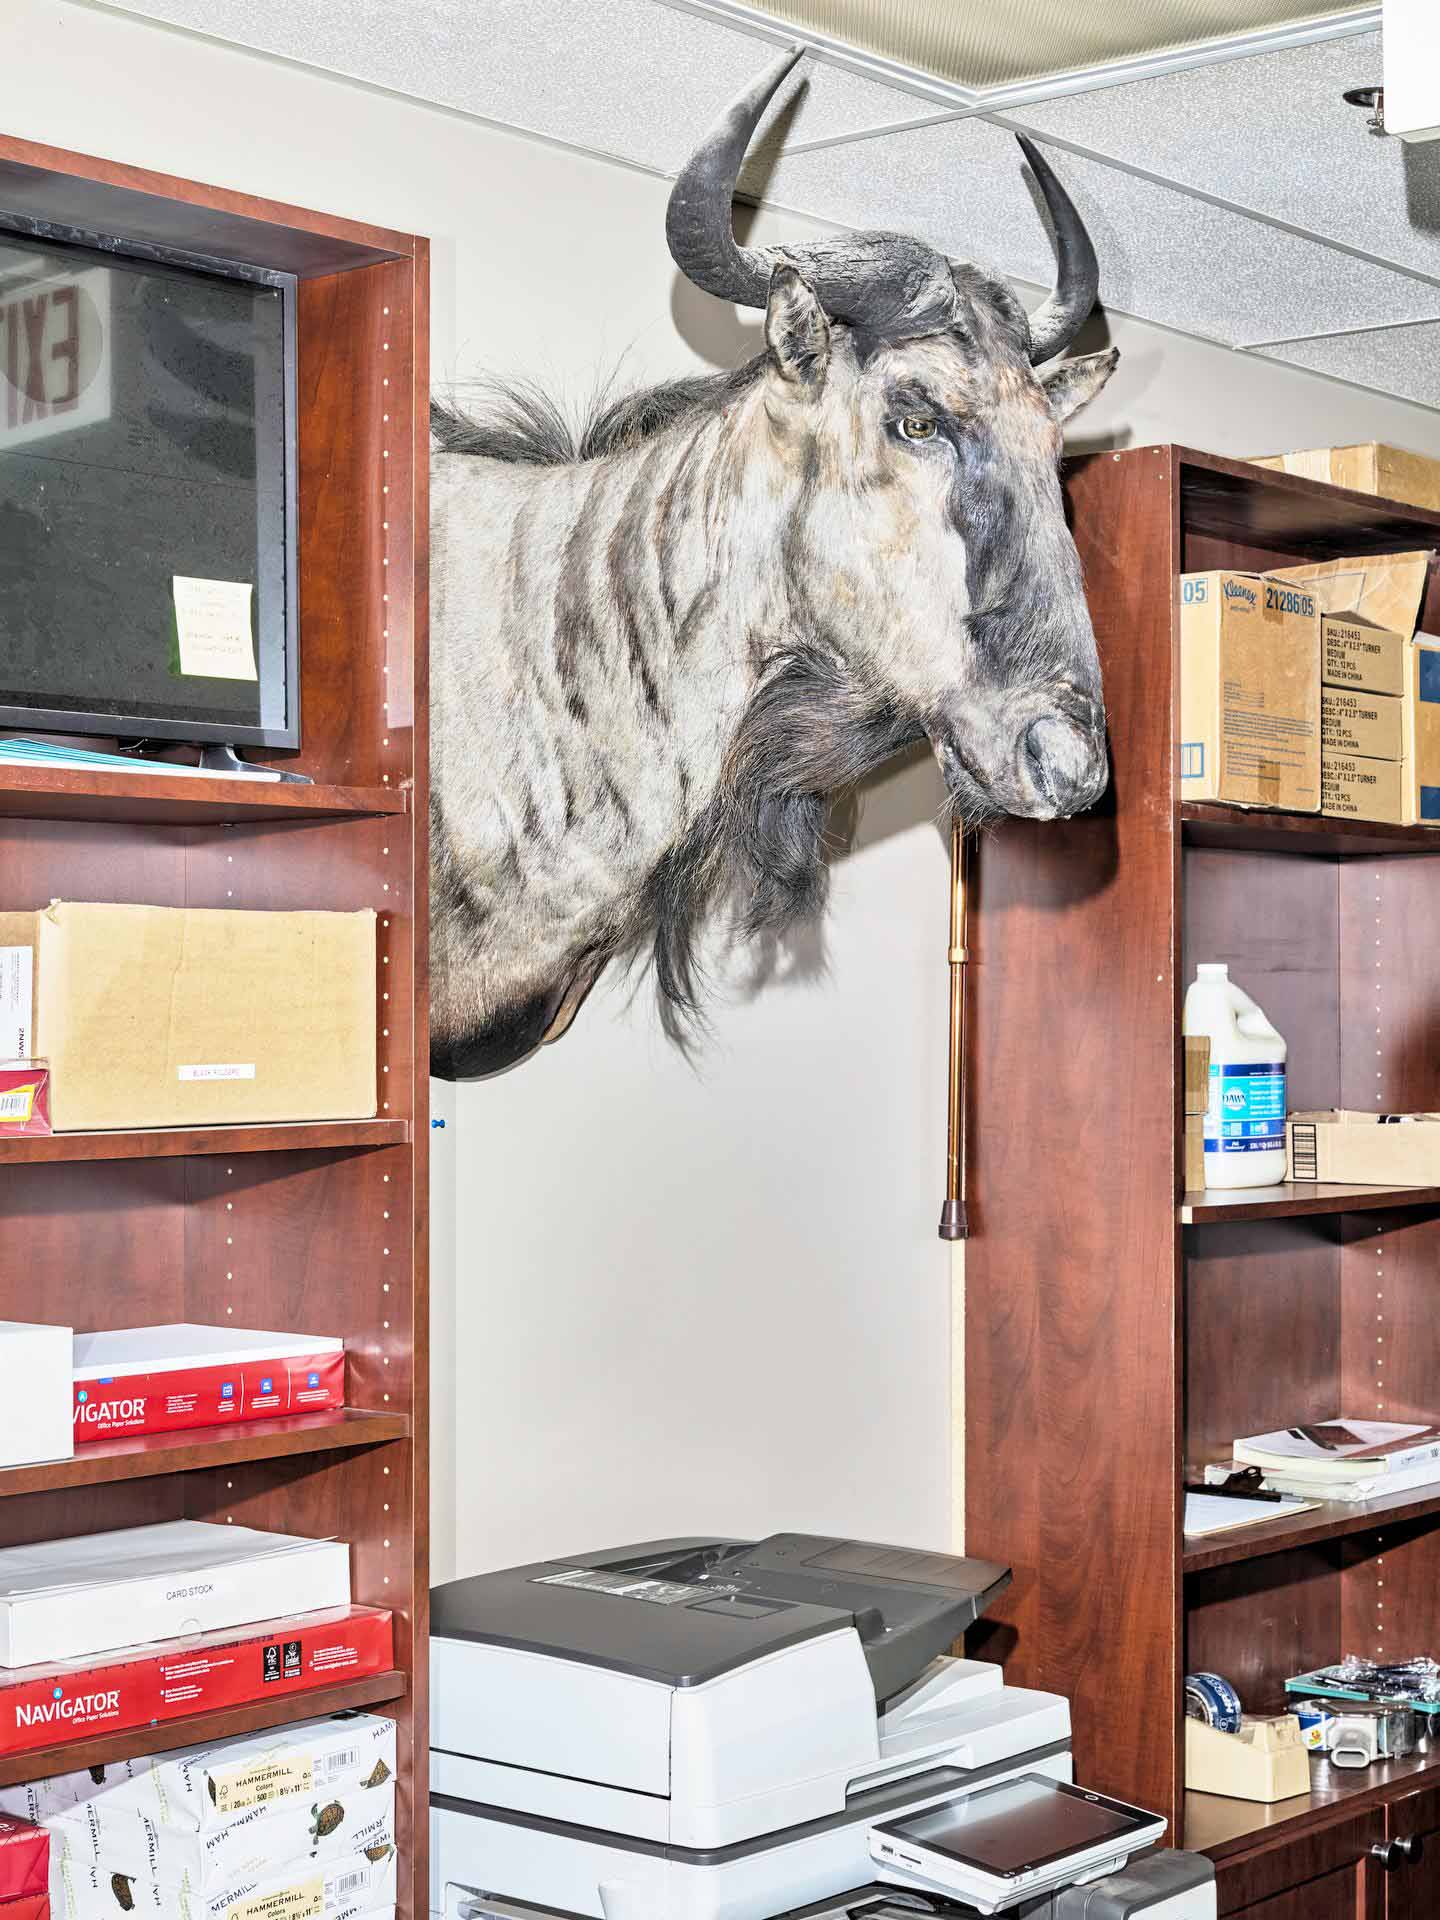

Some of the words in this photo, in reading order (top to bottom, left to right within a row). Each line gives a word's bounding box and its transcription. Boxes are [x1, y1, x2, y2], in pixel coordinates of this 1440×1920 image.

[1184, 580, 1206, 602] 05
[1223, 579, 1257, 606] Kleenex
[166, 1588, 188, 1601] CARD
[188, 1584, 214, 1597] STOCK
[15, 1690, 120, 1728] NAVIGATOR
[235, 1767, 293, 1788] HAMMERMILL
[255, 1782, 274, 1793] Colors
[246, 1891, 305, 1915] HAMMERMILL
[267, 1908, 286, 1919] Colors
